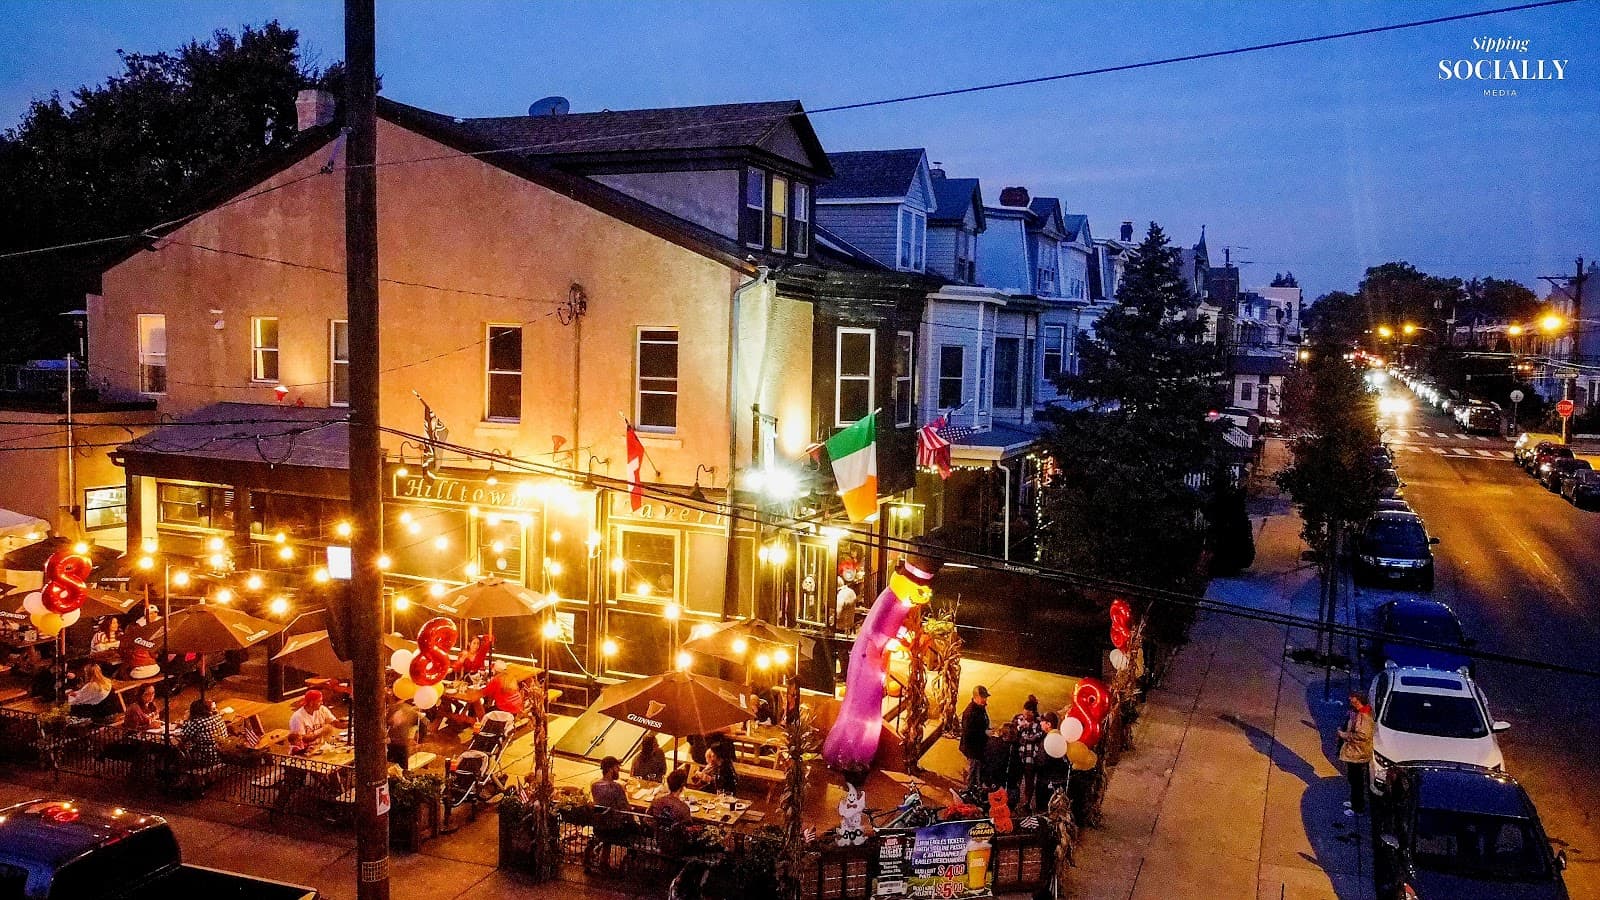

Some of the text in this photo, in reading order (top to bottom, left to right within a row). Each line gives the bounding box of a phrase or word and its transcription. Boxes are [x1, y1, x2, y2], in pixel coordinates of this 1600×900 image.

[404, 478, 729, 526] Hilltown avern
[627, 713, 662, 729] GUINNESS
